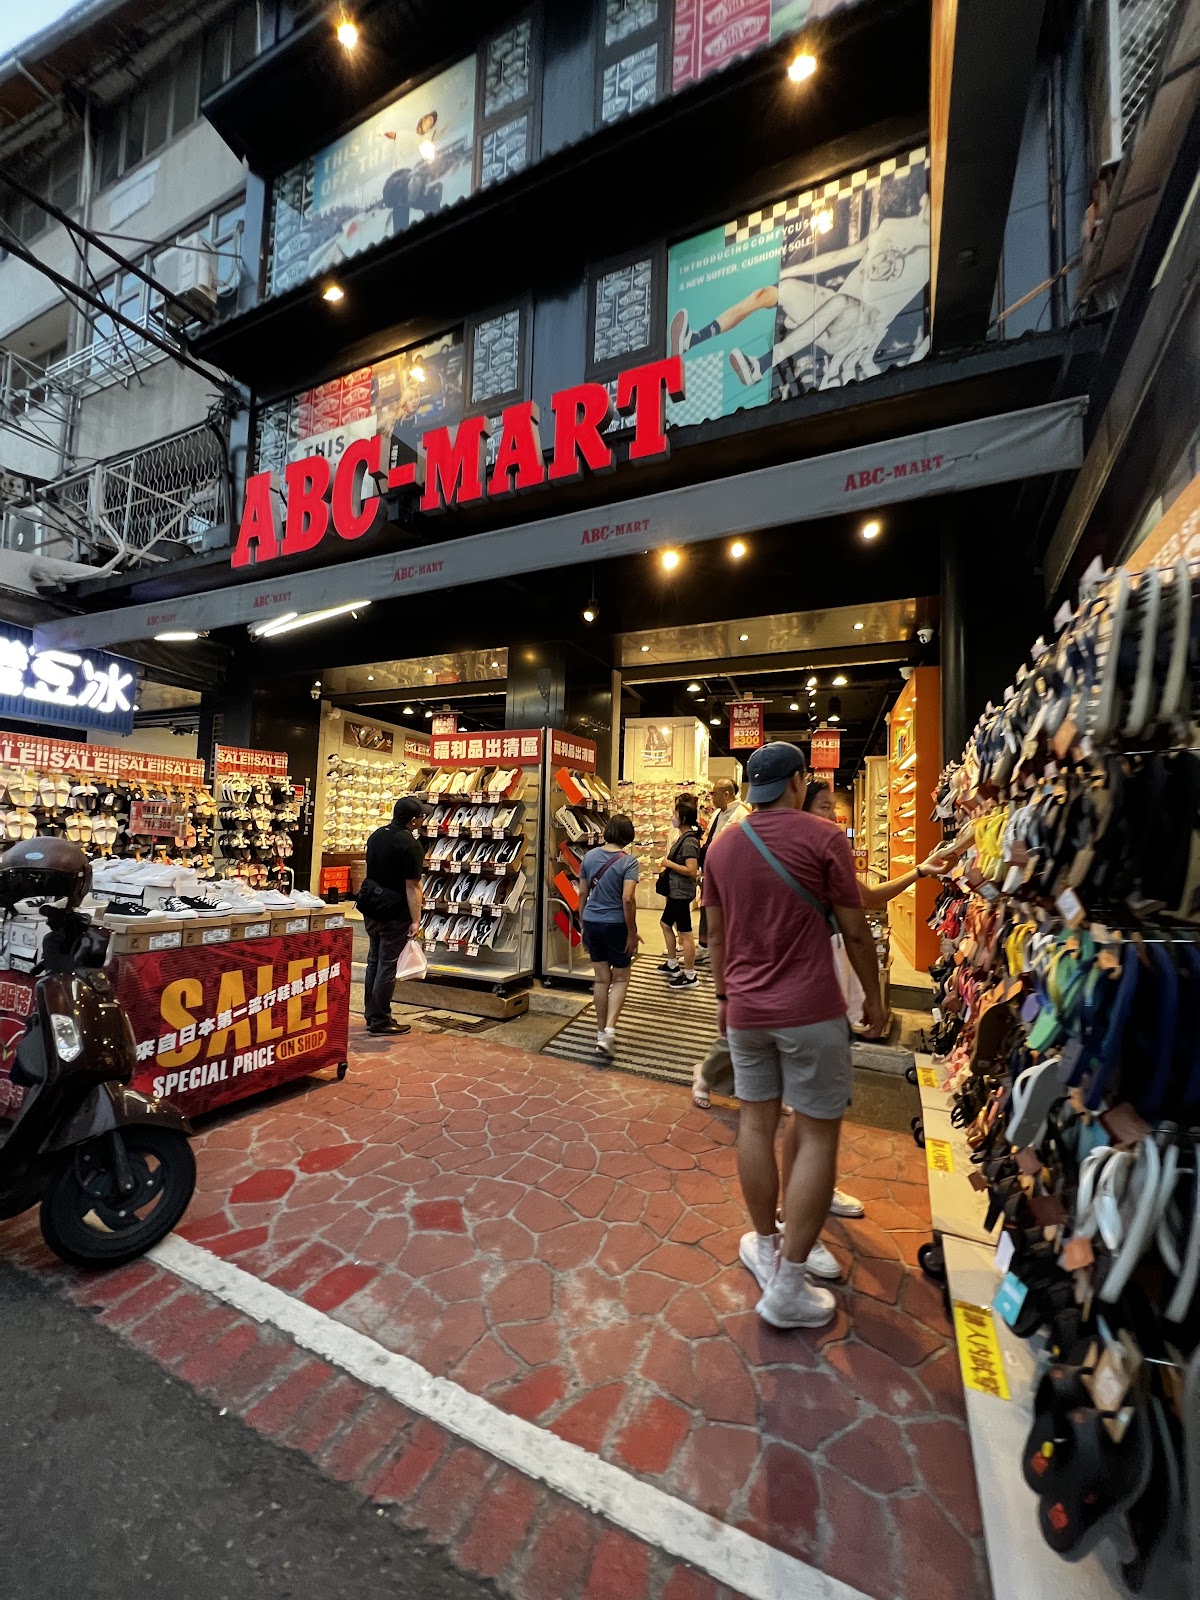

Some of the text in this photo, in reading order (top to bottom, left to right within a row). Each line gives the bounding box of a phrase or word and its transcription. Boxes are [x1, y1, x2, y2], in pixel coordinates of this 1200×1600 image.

[679, 219, 818, 275] INTRODUCING COMFYCUS
[686, 277, 705, 289] NEW
[741, 244, 787, 270] CUSHIONY
[303, 435, 345, 459] THIS
[231, 355, 684, 568] ABC-MART
[844, 454, 945, 493] ABC-MART
[580, 519, 650, 545] ABC-MART
[393, 560, 444, 582] ABC-MART
[254, 591, 292, 608] ABC-MART
[17, 743, 50, 751] OFFER
[51, 746, 91, 757] SPECIAL
[92, 751, 120, 760] OFFER
[433, 736, 539, 760] 福利品出清區
[553, 739, 595, 763] 福利品出清區
[559, 813, 577, 837] CONVERSE
[155, 954, 330, 1069] SALE!
[152, 1032, 324, 1099] SPECIAL PRICE ON SHOP
